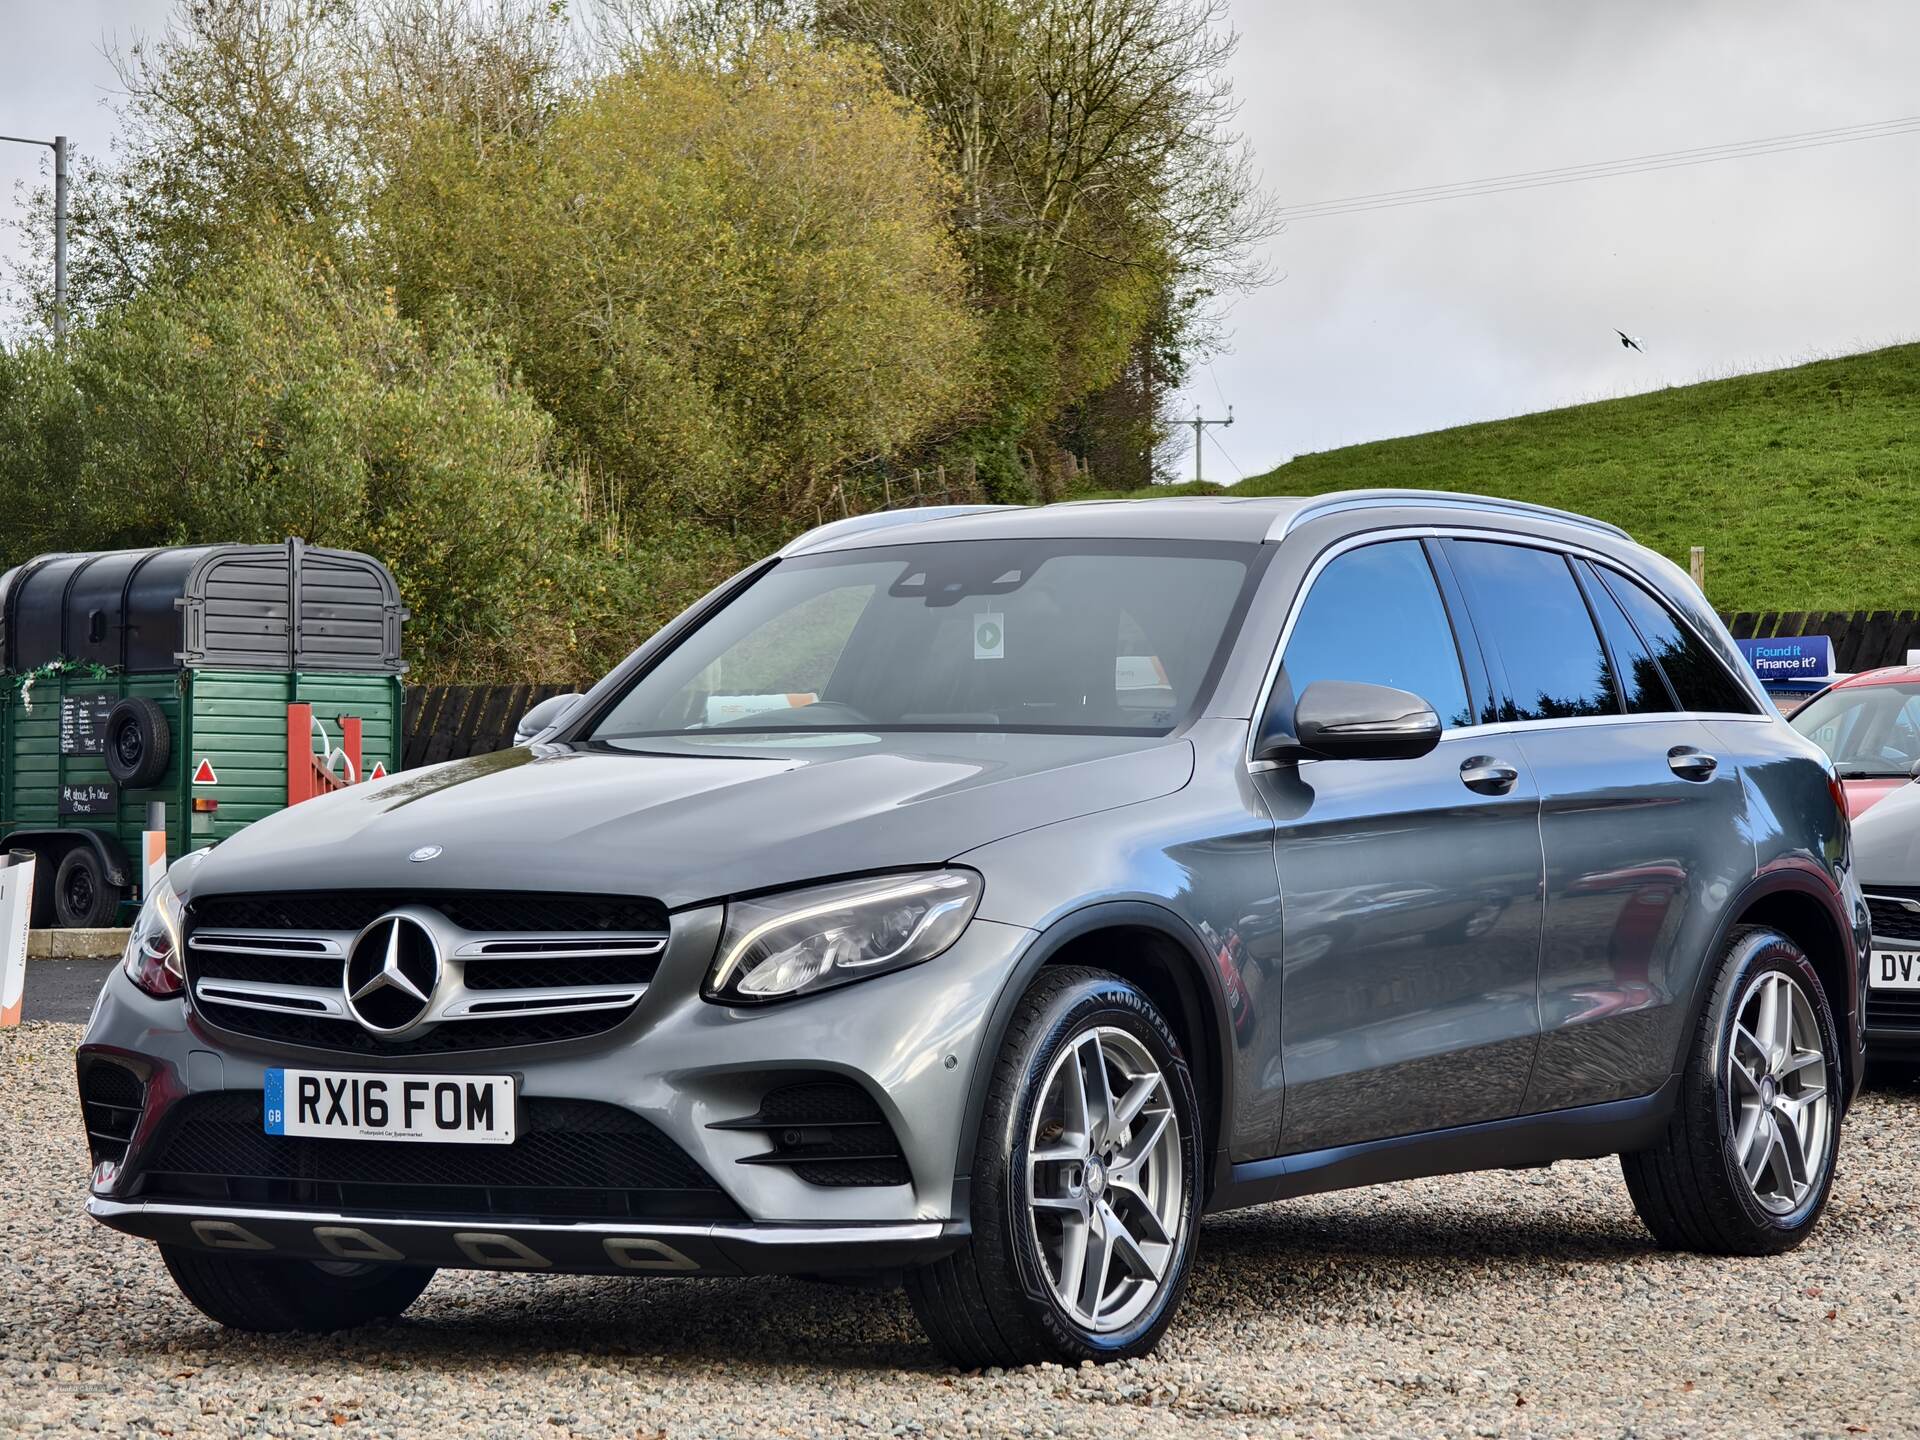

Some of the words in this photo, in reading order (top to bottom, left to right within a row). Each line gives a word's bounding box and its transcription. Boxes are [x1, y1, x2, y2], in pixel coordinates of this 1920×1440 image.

[1756, 646, 1791, 657] Found
[1793, 645, 1801, 656] it
[1756, 658, 1799, 669] Finance
[1801, 657, 1817, 668] it?
[1881, 954, 1920, 982] DV
[299, 1076, 389, 1128] RX16
[403, 1081, 494, 1131] FOM
[268, 1109, 281, 1123] GB
